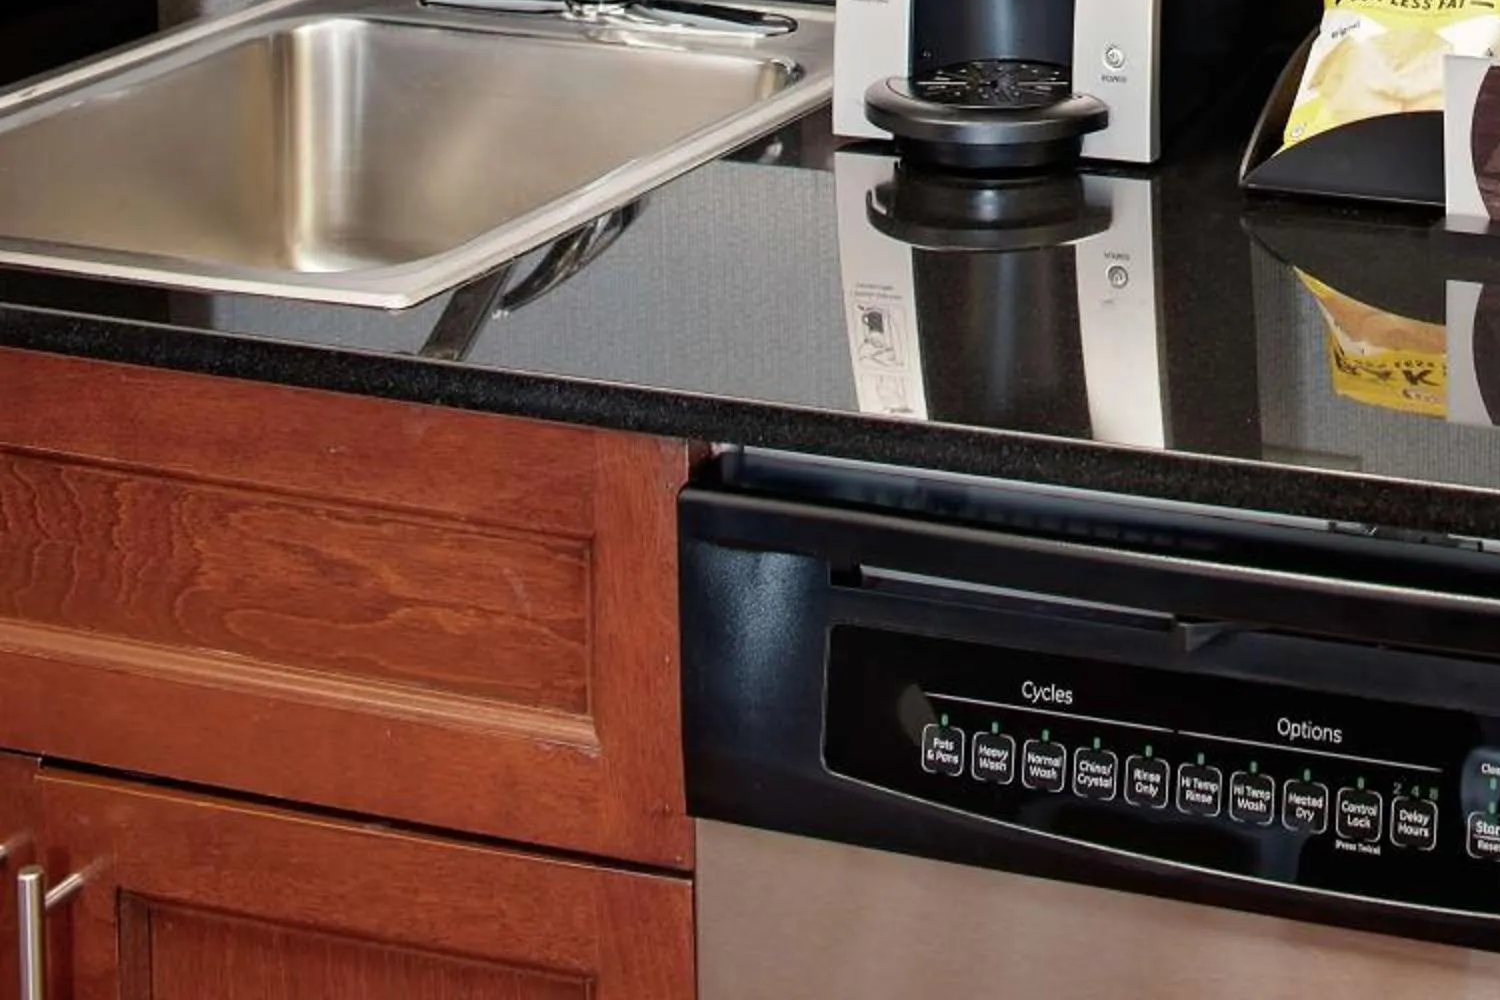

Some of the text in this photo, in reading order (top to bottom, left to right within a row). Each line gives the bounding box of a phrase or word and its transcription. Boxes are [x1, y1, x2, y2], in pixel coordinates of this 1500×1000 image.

[1021, 680, 1073, 705] Cycles
[1277, 717, 1343, 743] Options
[932, 737, 954, 751] Pots
[927, 750, 959, 765] & Pans
[979, 744, 1009, 761] Heavy
[1027, 751, 1062, 768] Normal
[979, 757, 1007, 772] Wash
[1029, 764, 1058, 780] Wash
[1079, 759, 1112, 775] China/
[1077, 772, 1113, 788] Crystal
[1133, 767, 1161, 783] Rinse
[1135, 781, 1159, 798] Only
[1181, 776, 1218, 794] Hi Temp
[1233, 783, 1271, 801] Hi Temp
[1393, 781, 1402, 796] 2
[1411, 784, 1420, 799] 4
[1185, 790, 1213, 804] Rinse
[1288, 792, 1323, 809] Heated
[1237, 798, 1267, 813] Wash
[1341, 800, 1378, 817] Control
[1295, 806, 1315, 822] Dry
[1346, 814, 1371, 829] Lock
[1400, 809, 1430, 826] Delay
[1398, 823, 1430, 838] Hours
